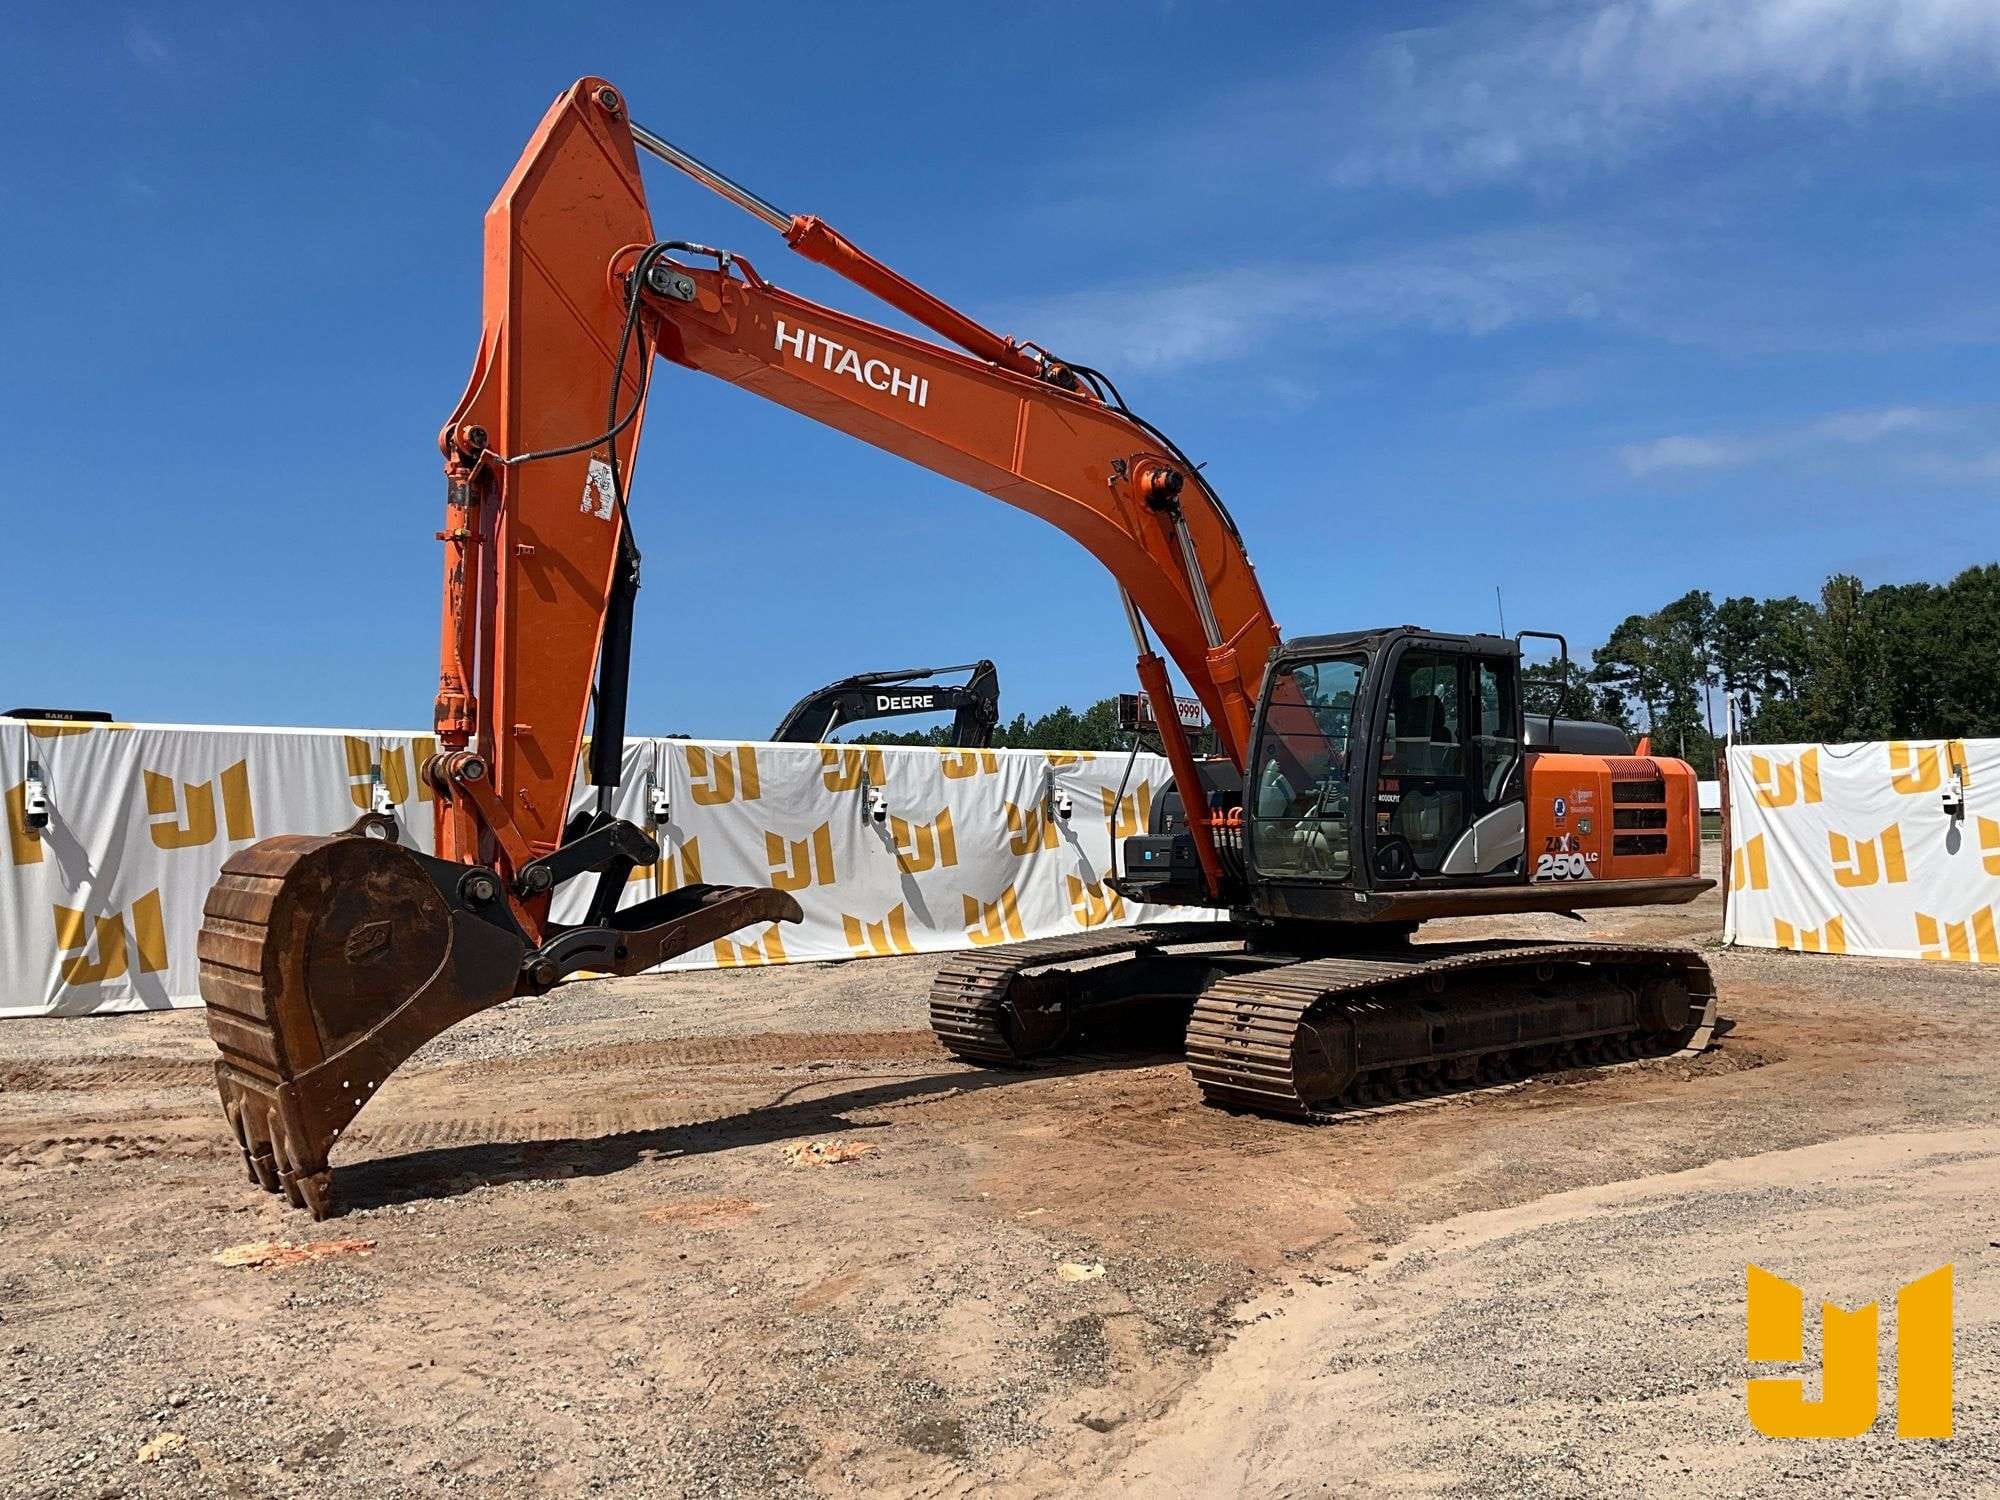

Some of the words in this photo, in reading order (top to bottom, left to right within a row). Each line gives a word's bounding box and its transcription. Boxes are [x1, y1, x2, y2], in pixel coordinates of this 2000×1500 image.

[774, 320, 929, 408] HITACHI
[876, 695, 934, 711] DEERE
[1536, 852, 1586, 880] 250
[1585, 852, 1600, 862] LC
